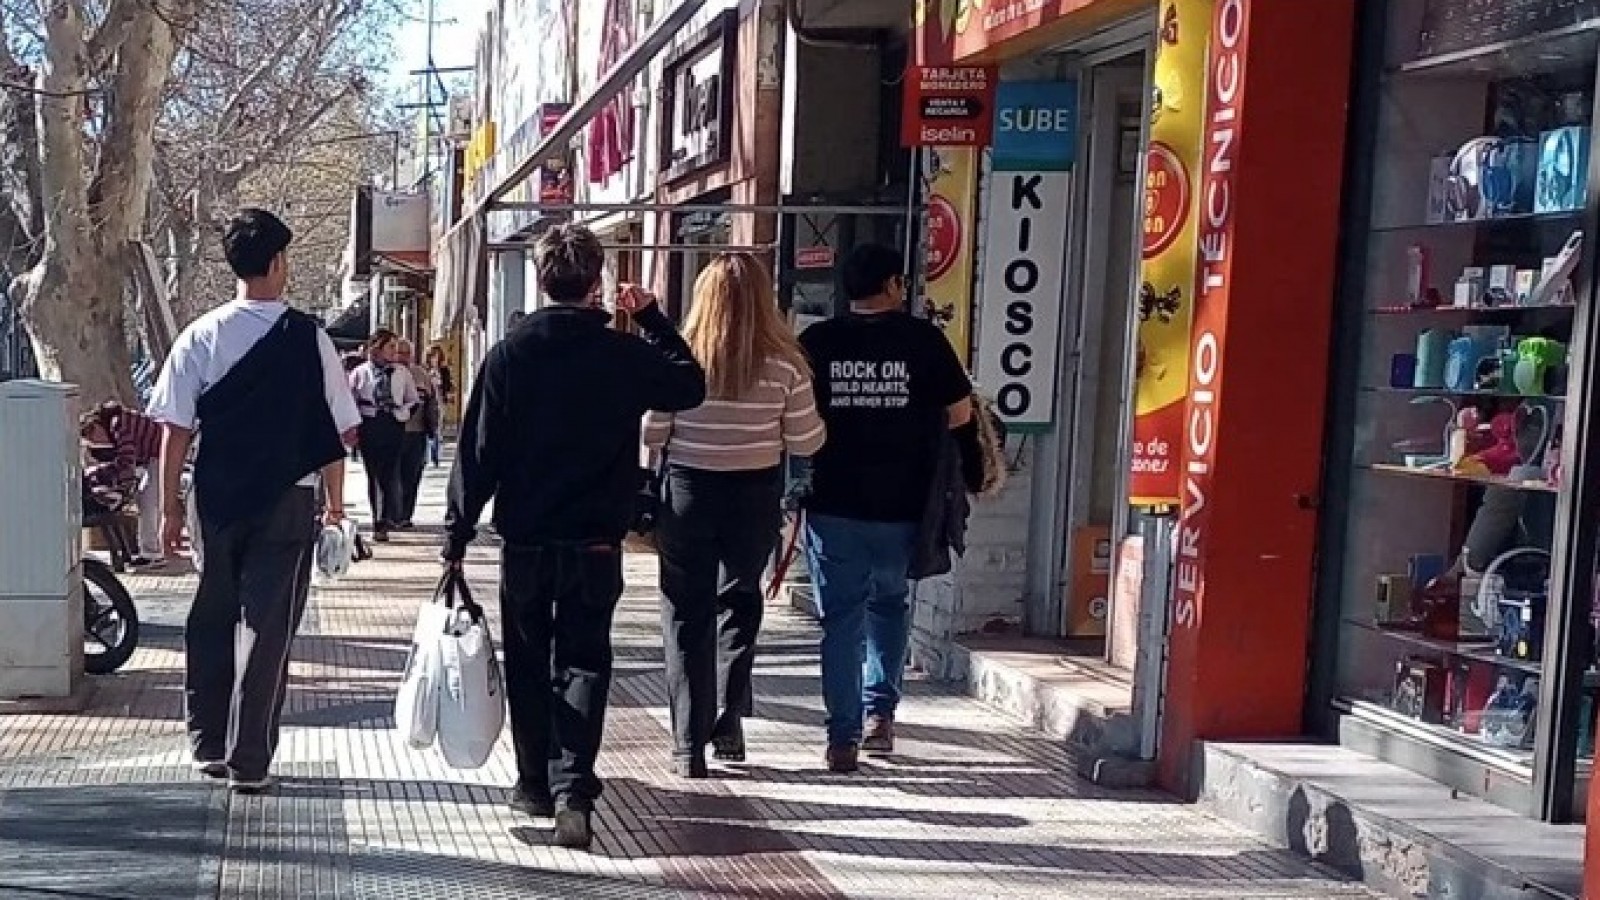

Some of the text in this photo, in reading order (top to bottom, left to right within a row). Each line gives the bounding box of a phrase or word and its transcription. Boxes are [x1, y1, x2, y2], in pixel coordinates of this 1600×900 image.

[920, 67, 987, 80] TARJETA
[999, 107, 1069, 132] SUBE
[920, 124, 975, 142] iselin
[997, 174, 1043, 417] KIOSCO
[1175, 0, 1242, 629] SERVICIO TÉCNICO
[830, 360, 910, 382] ROCK ON,
[1146, 435, 1169, 456] de
